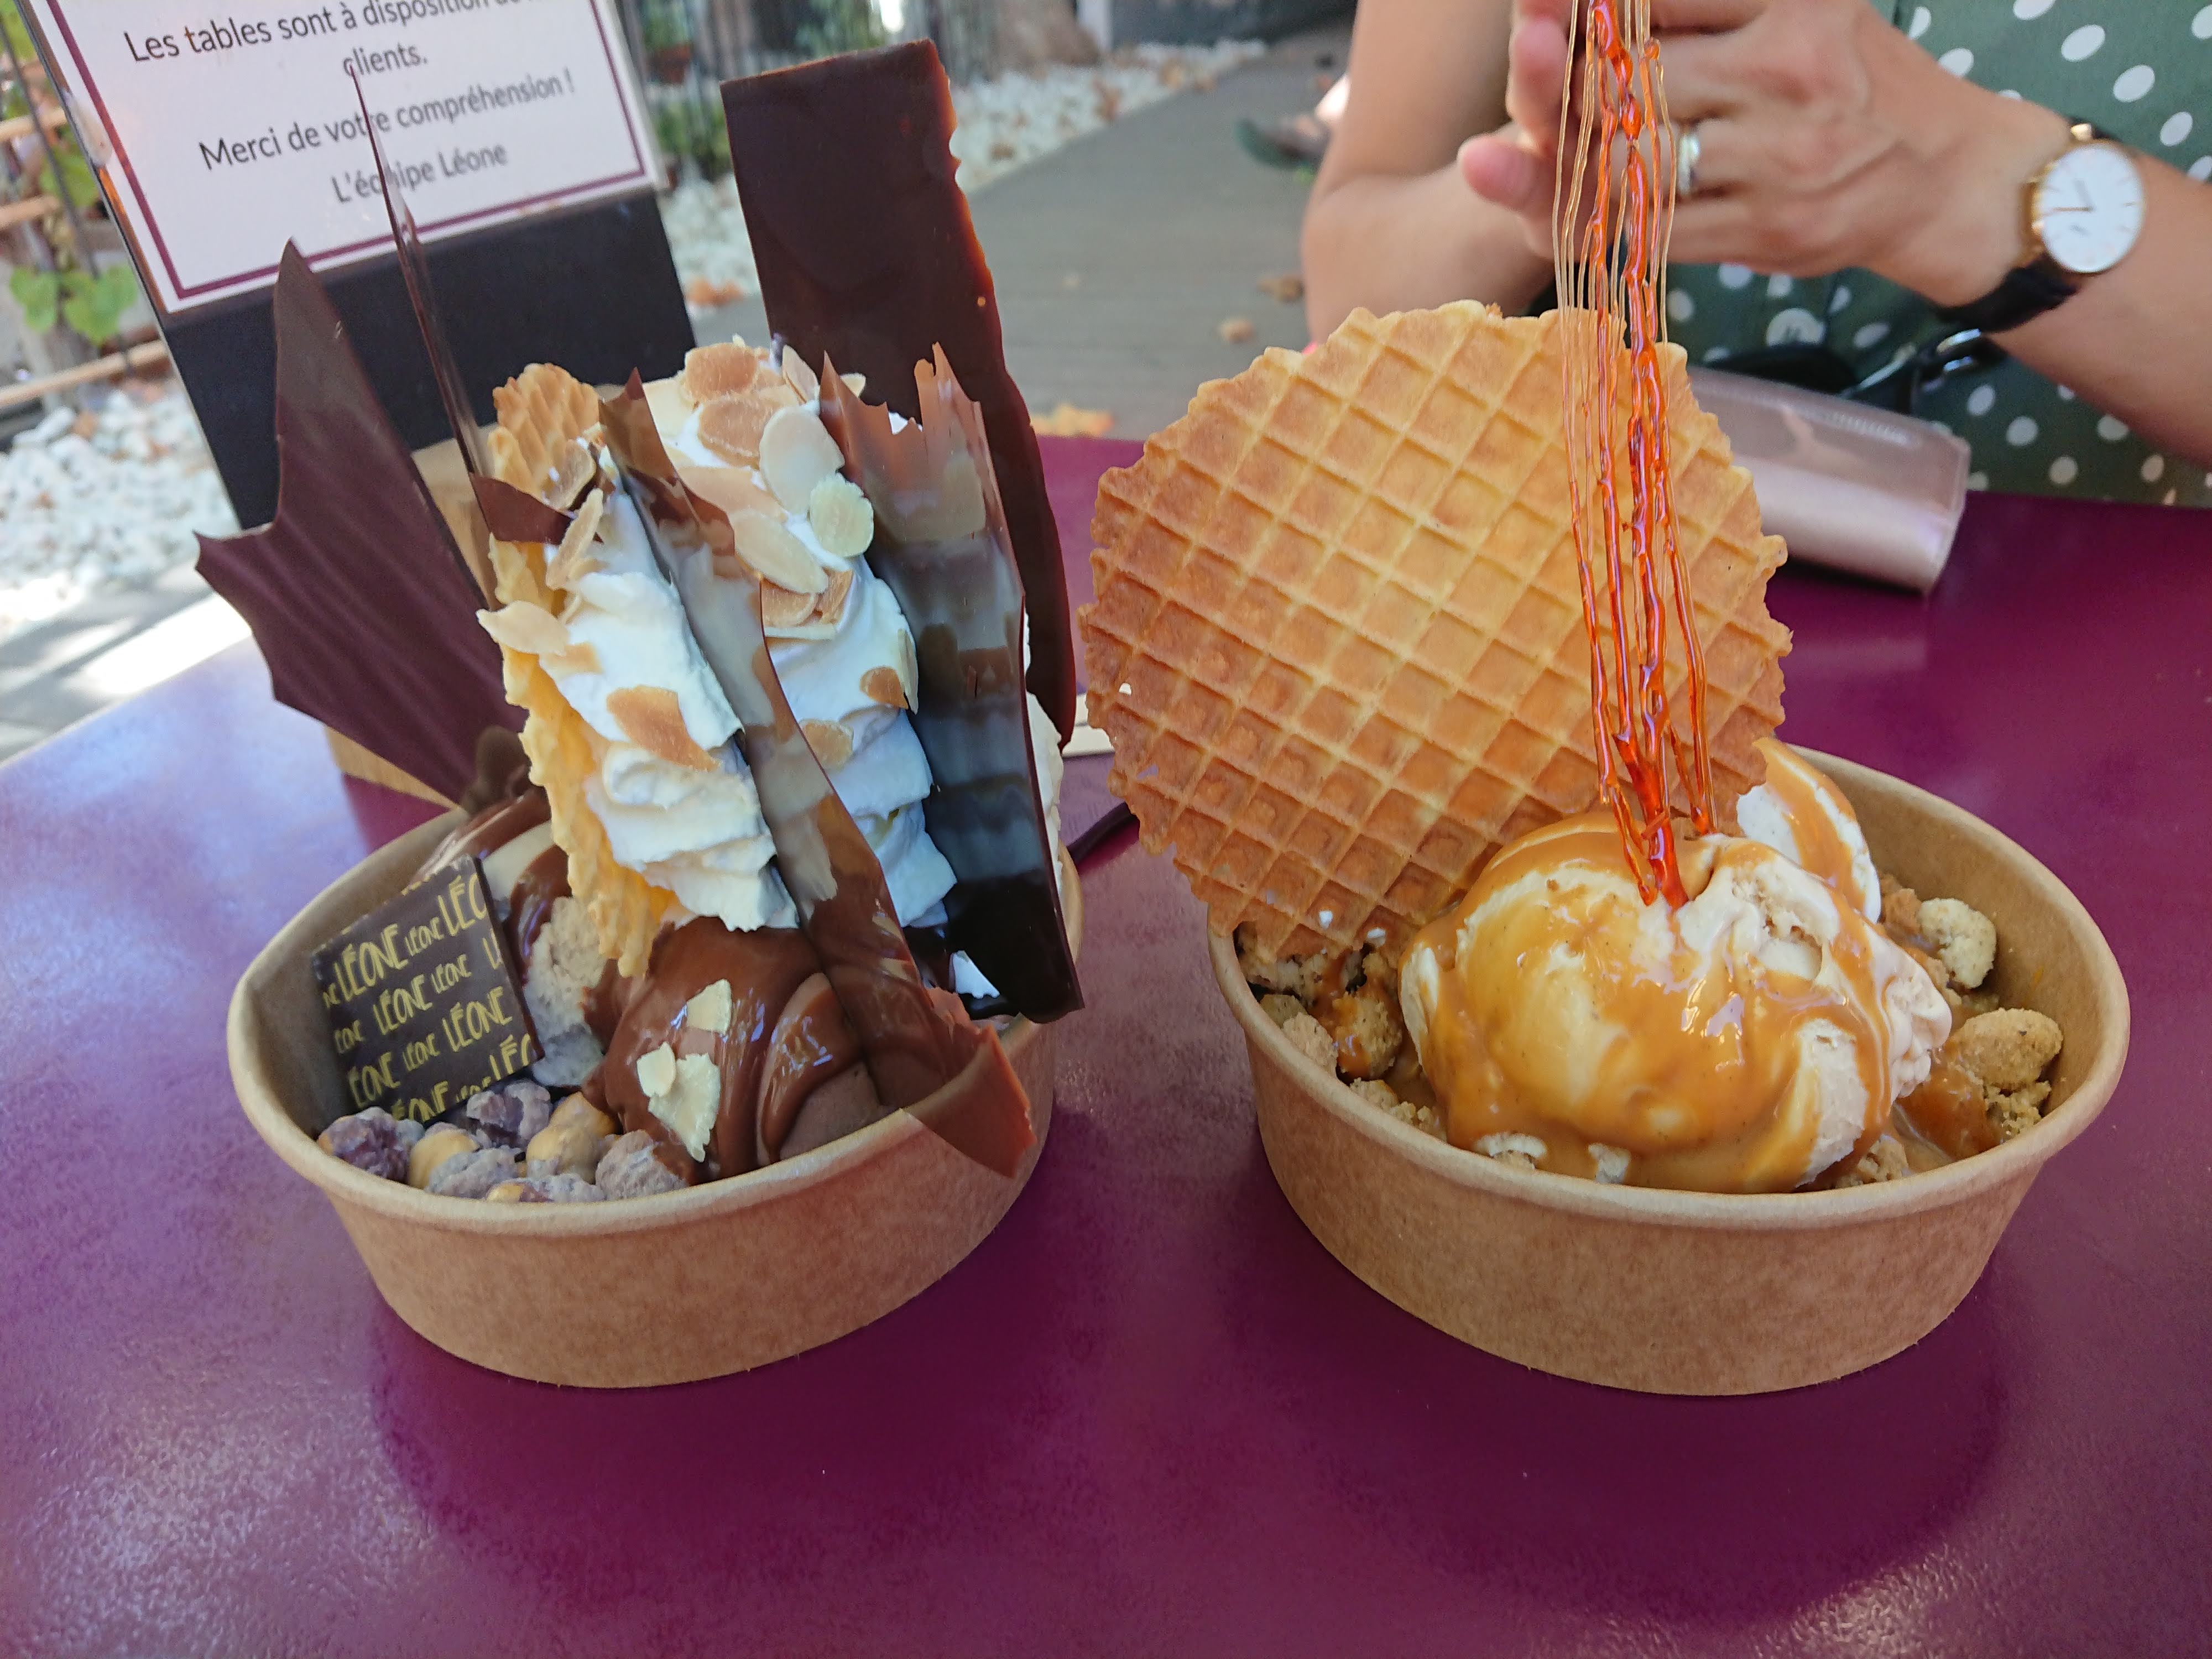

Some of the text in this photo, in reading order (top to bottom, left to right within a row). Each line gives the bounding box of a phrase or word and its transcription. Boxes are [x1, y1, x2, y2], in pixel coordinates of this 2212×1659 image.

[123, 31, 180, 61] Les
[184, 17, 272, 54] tables
[278, 6, 337, 39] sont
[340, 1, 357, 29] à
[343, 43, 428, 76] clients.
[199, 126, 281, 171] Merci
[288, 117, 321, 150] de
[396, 72, 563, 124] compréhension
[438, 145, 508, 178] Léone
